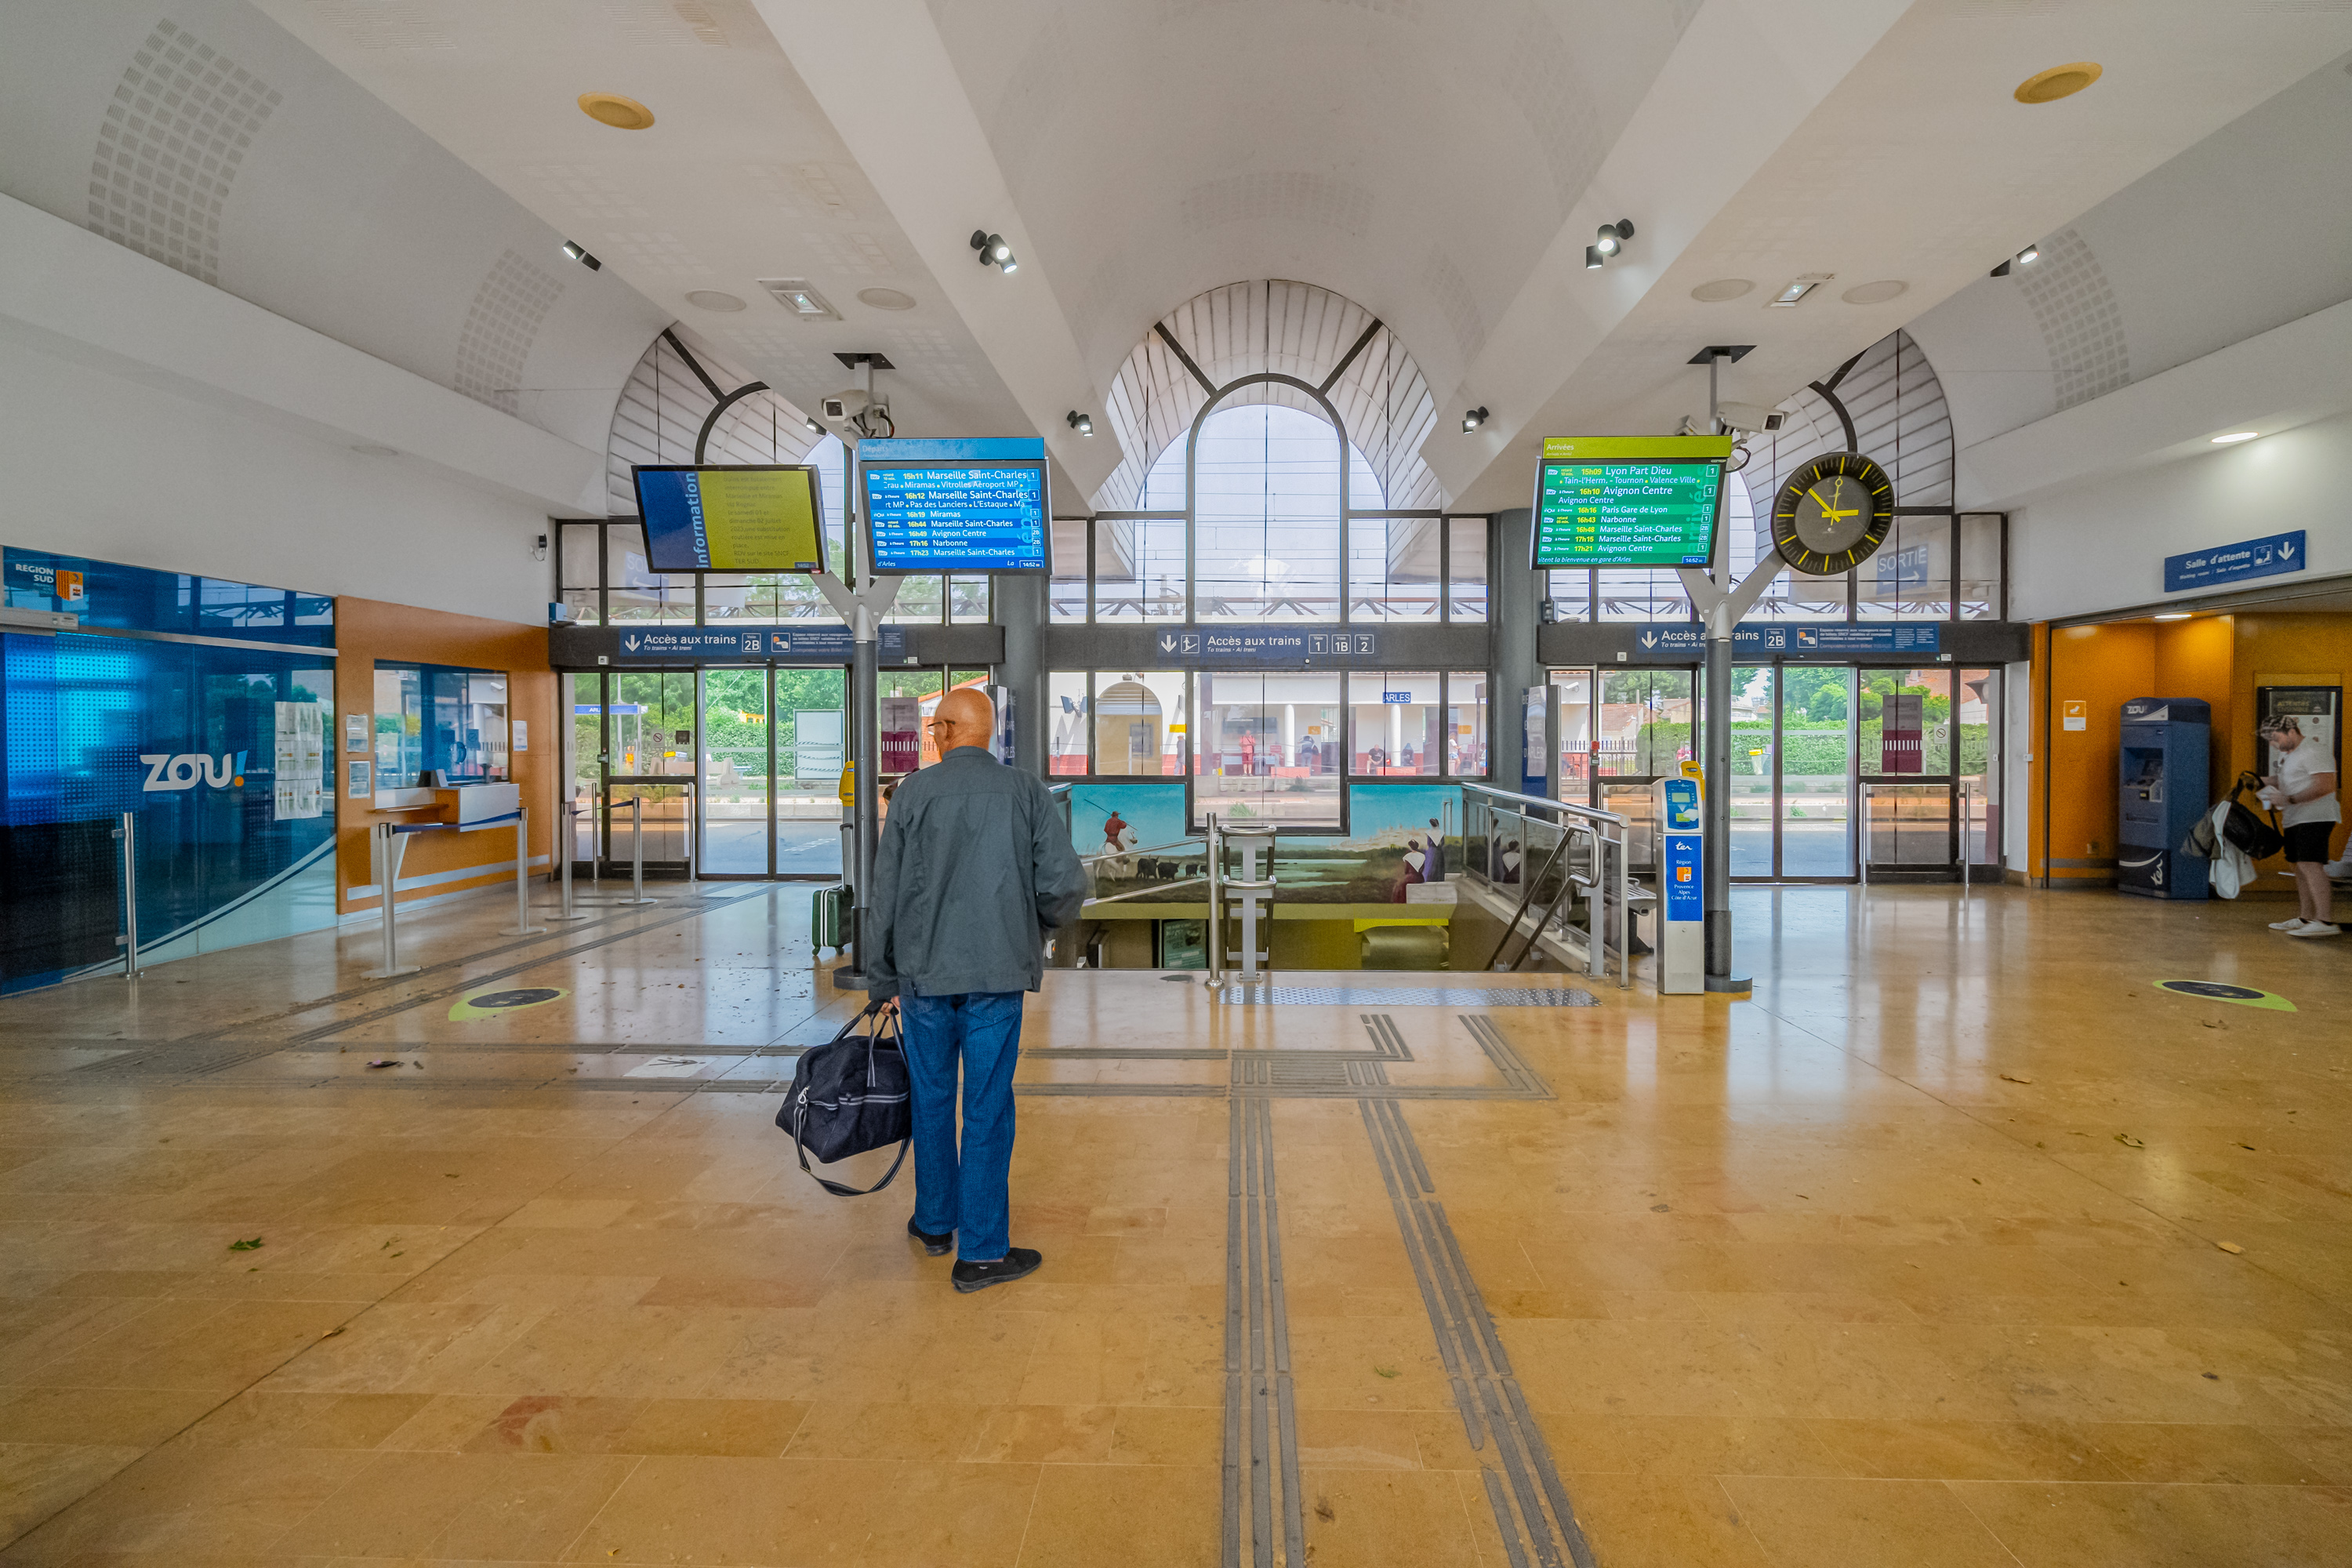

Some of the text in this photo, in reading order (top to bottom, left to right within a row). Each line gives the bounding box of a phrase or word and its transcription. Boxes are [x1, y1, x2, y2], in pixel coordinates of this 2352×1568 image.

[927, 470, 966, 480] Marseille
[968, 470, 1027, 480] Saint-Charles
[1606, 466, 1628, 477] Lyon
[1629, 466, 1649, 475] Part
[1650, 466, 1672, 475] Dieu
[973, 481, 1005, 489] Aéroport
[970, 490, 1029, 499] Saint-Charles
[1603, 486, 1639, 497] Avignon
[1642, 485, 1673, 495] Centre
[974, 500, 1008, 509] L'Estaque
[1559, 496, 1588, 506] Avignon
[1650, 506, 1668, 514] Lyon
[685, 473, 710, 568] information
[965, 519, 1013, 528] Saint-Charles
[932, 530, 961, 539] Avignon
[1597, 544, 1627, 554] Avignon
[1878, 548, 1927, 573] SORTIE
[2185, 551, 2251, 569] Salle d'attente
[16, 564, 54, 575] REGION
[34, 575, 54, 583] SUD
[644, 633, 737, 644] Accès aux trains
[1207, 635, 1301, 646] Accès aux trains
[1661, 630, 1697, 641] Accès
[1731, 630, 1759, 641] rains
[744, 640, 760, 651] 2B
[1316, 641, 1321, 652] 1
[1334, 641, 1348, 652] 1B
[1361, 641, 1368, 652] 2
[1767, 636, 1784, 647] 2B
[1383, 693, 1410, 702] ARLES
[140, 750, 249, 792] ZOU!
[1675, 840, 1693, 851] ter
